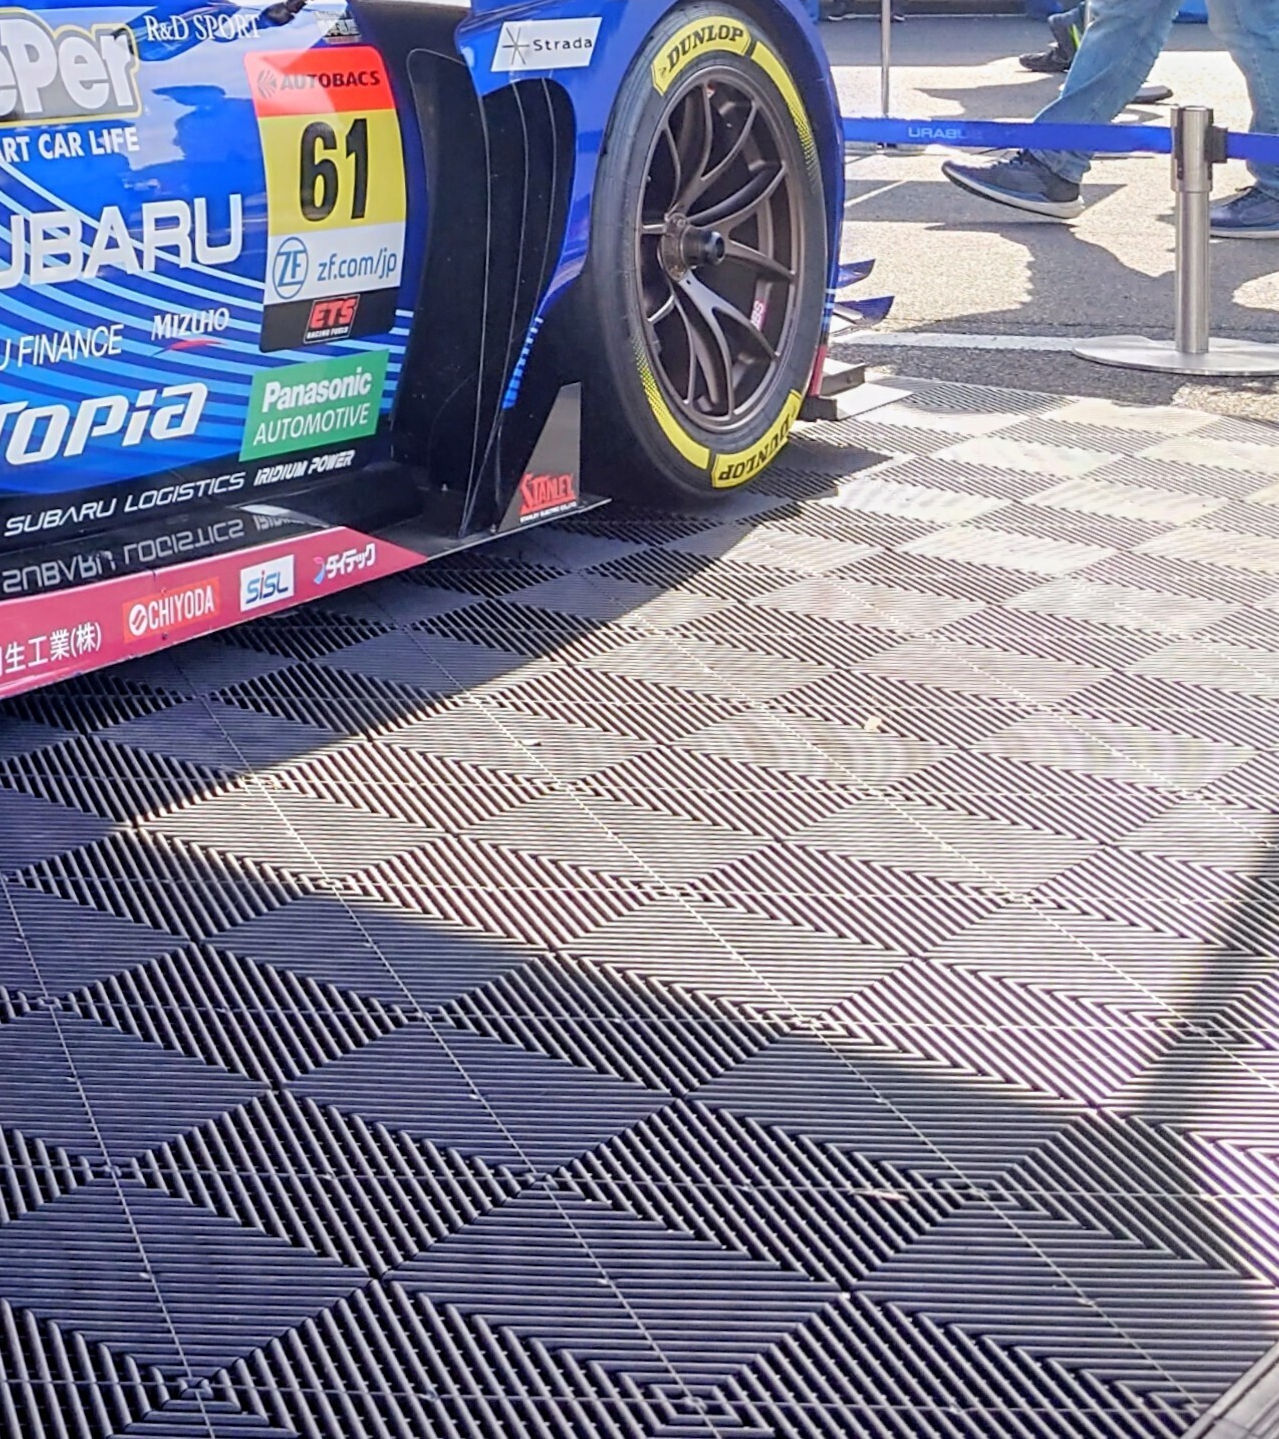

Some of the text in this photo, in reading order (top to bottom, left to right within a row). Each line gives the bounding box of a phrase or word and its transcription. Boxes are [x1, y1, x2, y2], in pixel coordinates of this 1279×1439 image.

[145, 13, 261, 42] R&D SPORT
[533, 36, 592, 51] Strada
[668, 25, 744, 73] DUNLOP
[280, 70, 380, 90] AUTOBACS
[38, 132, 84, 160] CAR
[91, 128, 139, 155] LIFE
[300, 118, 368, 222] 61
[277, 249, 306, 287] ZF
[317, 247, 397, 282] zf.com/jp
[152, 308, 230, 341] MIZUHO
[310, 297, 357, 329] ETS
[17, 325, 125, 367] FINANCE
[261, 367, 372, 413] Panasonic
[253, 403, 371, 446] AUTOMOTIVE
[254, 450, 355, 486] IRIDIUM POWER
[4, 472, 245, 537] SUBARU LOGISTICS
[148, 587, 215, 629] CHIYODA
